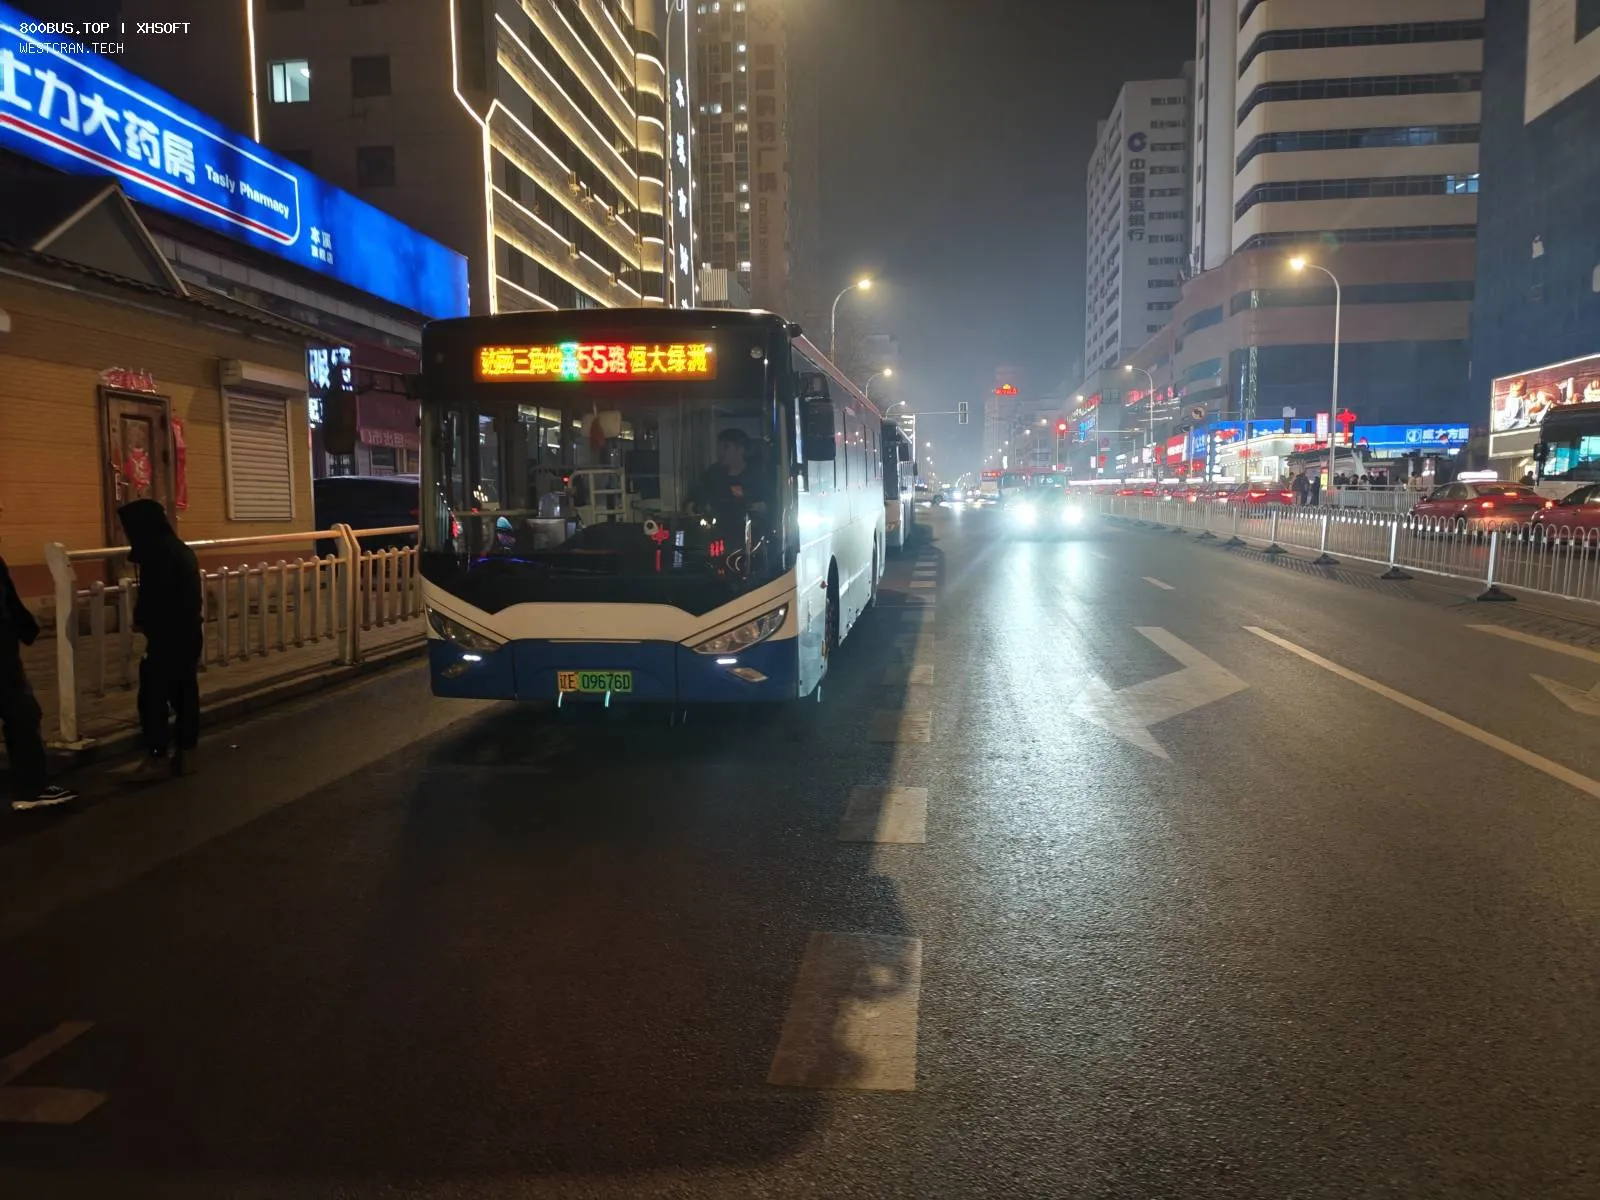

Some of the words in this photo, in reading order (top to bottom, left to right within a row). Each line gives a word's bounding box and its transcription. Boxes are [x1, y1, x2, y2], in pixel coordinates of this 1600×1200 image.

[205, 163, 235, 194] Tasly
[239, 180, 290, 220] Pharmacy
[1127, 158, 1147, 241] 中国建设银行
